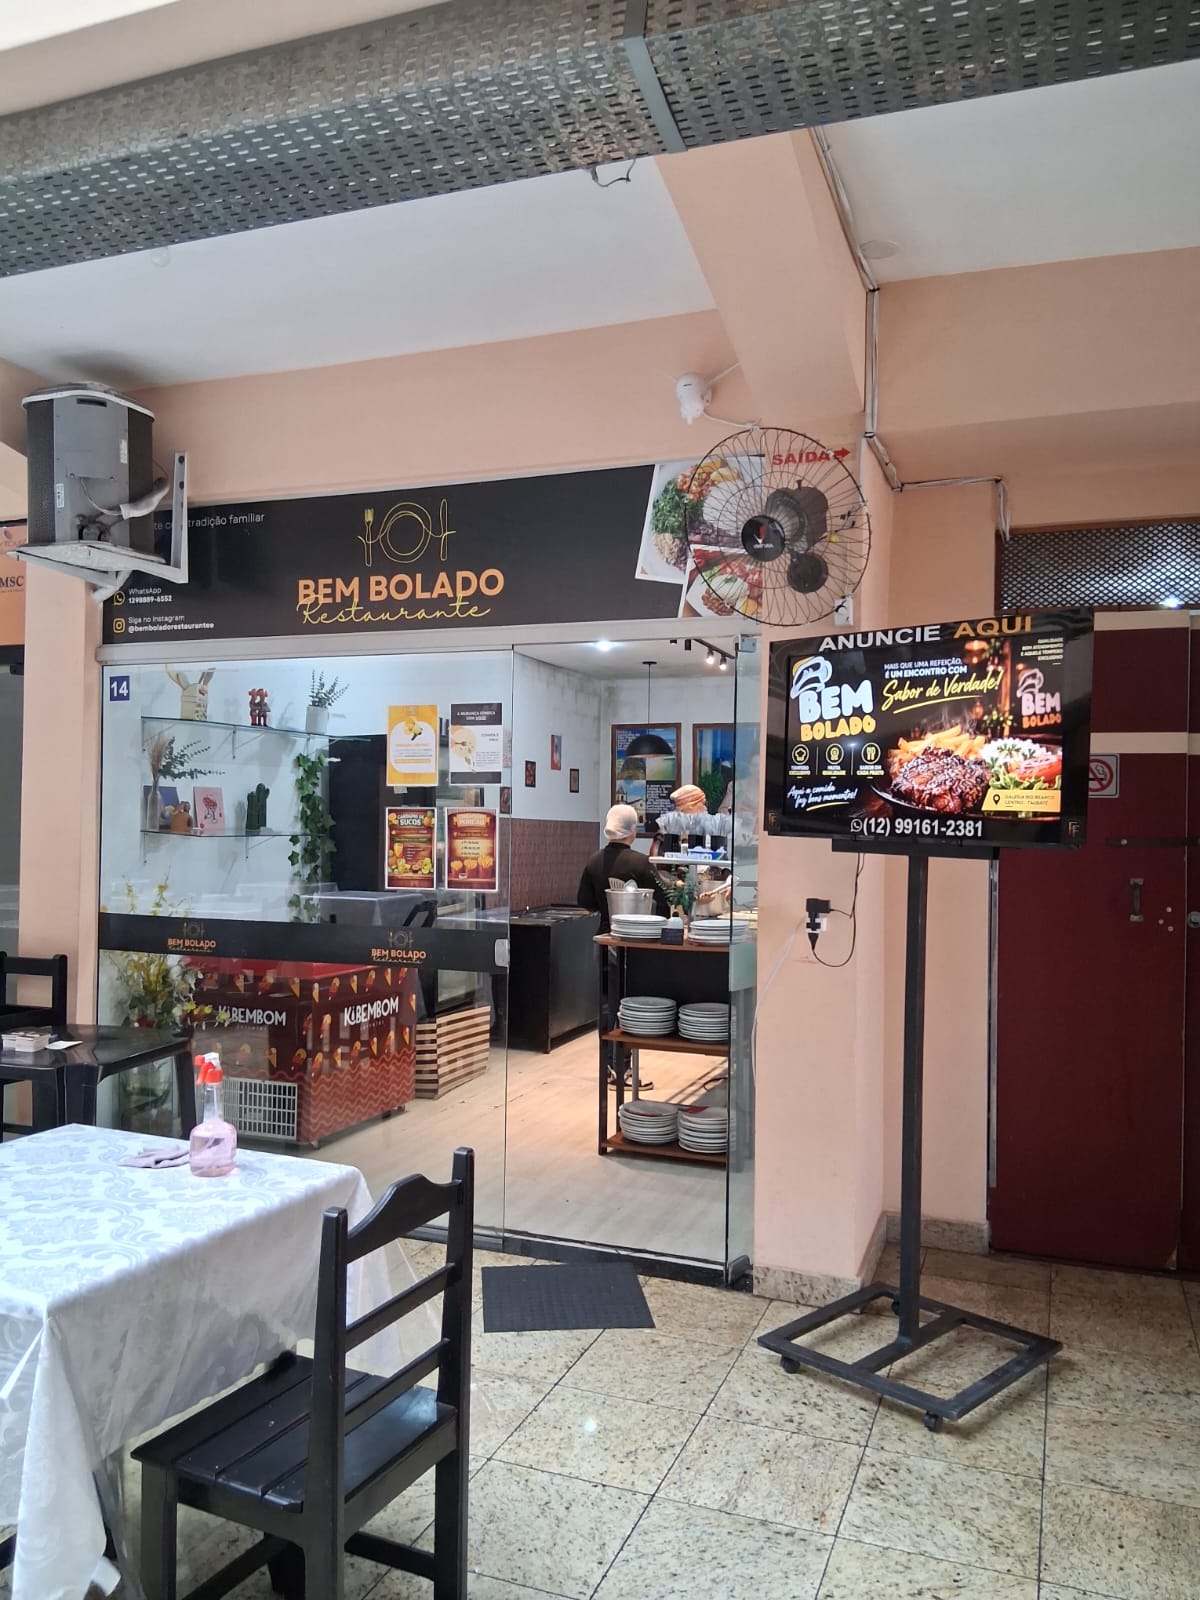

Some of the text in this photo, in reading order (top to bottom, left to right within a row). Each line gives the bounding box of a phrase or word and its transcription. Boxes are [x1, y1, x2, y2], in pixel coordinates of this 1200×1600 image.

[772, 449, 830, 465] SAÍDA
[187, 513, 264, 528] tradição familiar
[129, 587, 162, 596] WhatsApp
[298, 568, 505, 605] BEM BOLADO
[296, 594, 492, 624] Restaurante
[128, 615, 185, 625] Siga no Instagram
[819, 616, 1032, 652] ANUNCIE AQUI
[884, 662, 899, 670] MAIS
[900, 662, 913, 670] QUE
[885, 665, 968, 679] É UM ENCONTRO COM
[111, 680, 128, 696] 14
[881, 670, 1004, 711] Sabor de Verdade!
[799, 680, 874, 723] BEM
[1022, 692, 1061, 716] BEM
[800, 714, 876, 742] BOLADO
[1022, 714, 1062, 728] BOLADO
[787, 785, 804, 799] Aqui
[812, 782, 836, 794] comida
[808, 793, 822, 803] bons
[863, 817, 983, 837] (12) 99161-2381
[168, 938, 216, 948] BEM BOLADO
[371, 948, 426, 959] BEM BOLADO
